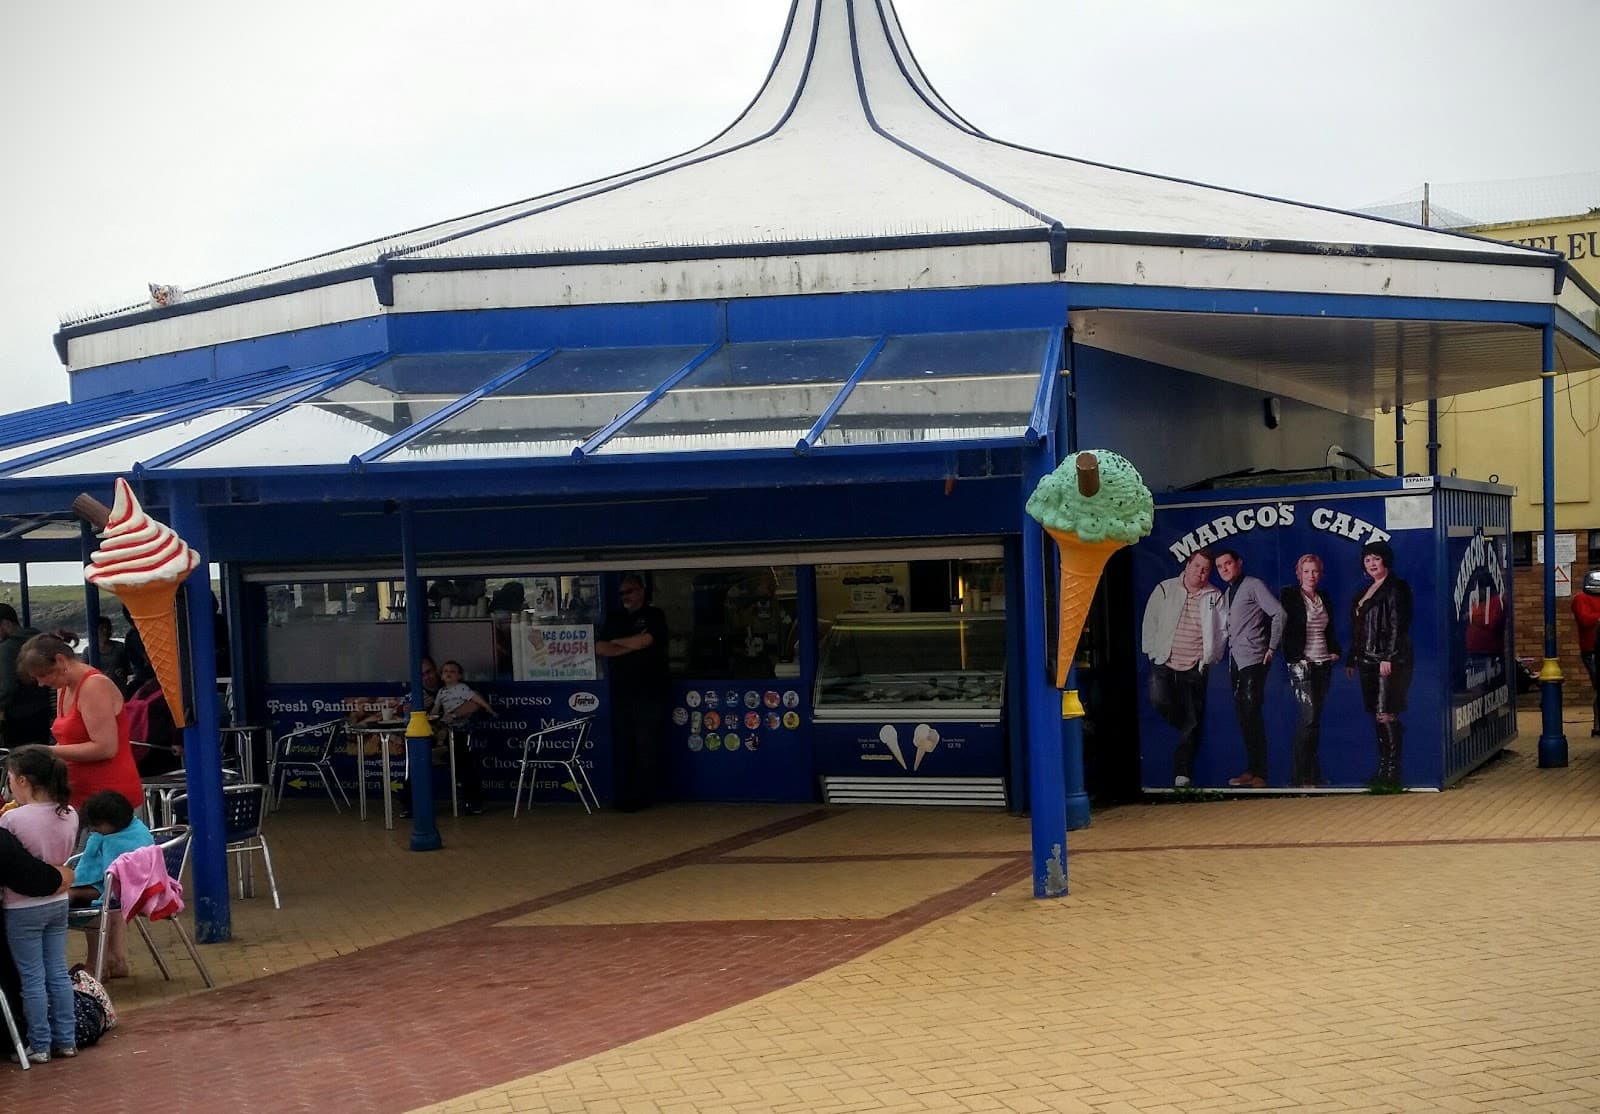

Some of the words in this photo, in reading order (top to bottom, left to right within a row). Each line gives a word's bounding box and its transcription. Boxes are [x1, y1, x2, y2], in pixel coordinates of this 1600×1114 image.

[1169, 502, 1295, 563] MARCO'S
[543, 631, 557, 640] ICE
[560, 631, 587, 640] COLD
[548, 641, 589, 654] SLUSH
[267, 699, 308, 714] Fresh
[312, 699, 360, 714] Panini
[364, 699, 389, 712] and
[488, 694, 552, 708] Espresso
[1456, 696, 1483, 731] BARRY
[1484, 684, 1509, 716] ISLAND
